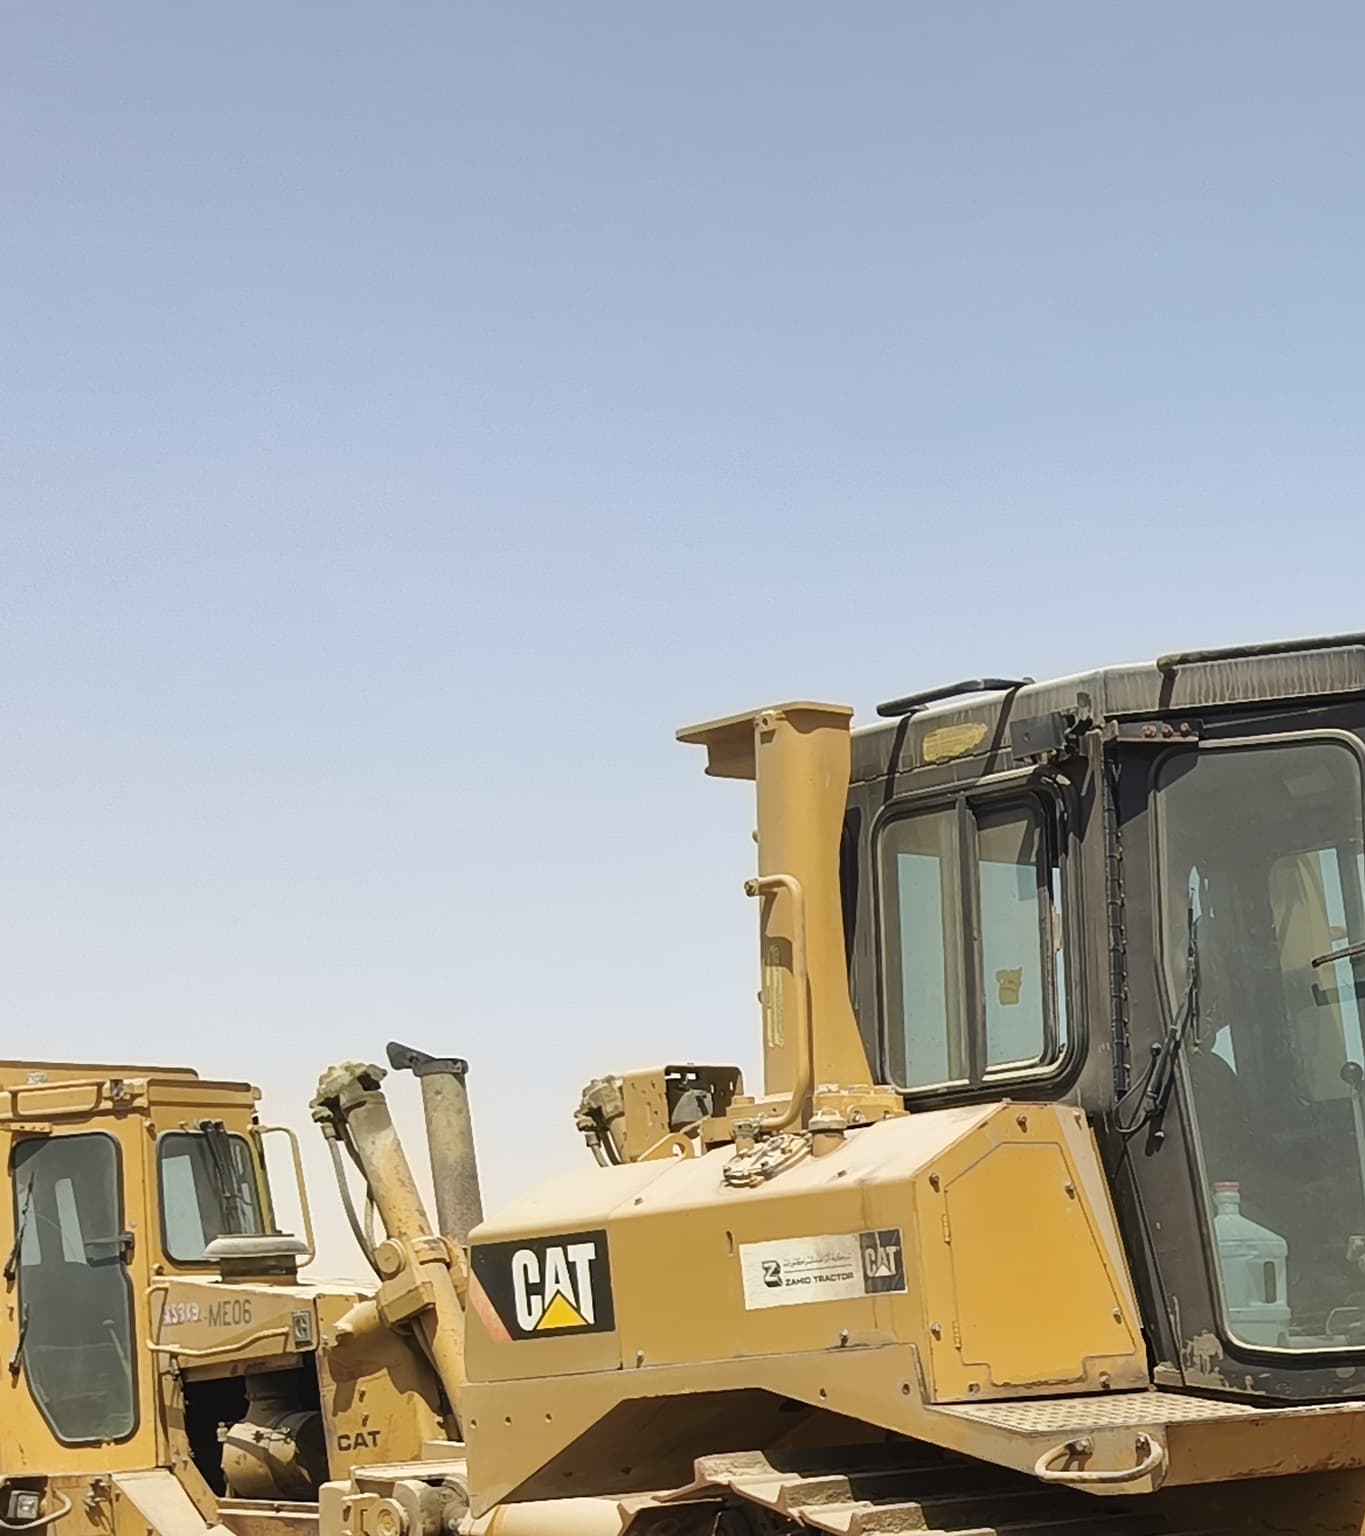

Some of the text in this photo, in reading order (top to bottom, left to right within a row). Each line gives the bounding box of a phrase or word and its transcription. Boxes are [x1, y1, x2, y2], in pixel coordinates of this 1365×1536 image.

[864, 1246, 898, 1278] CAT
[511, 1242, 596, 1332] CAT
[813, 1271, 854, 1284] TRACTOR
[337, 1430, 381, 1452] CAT
